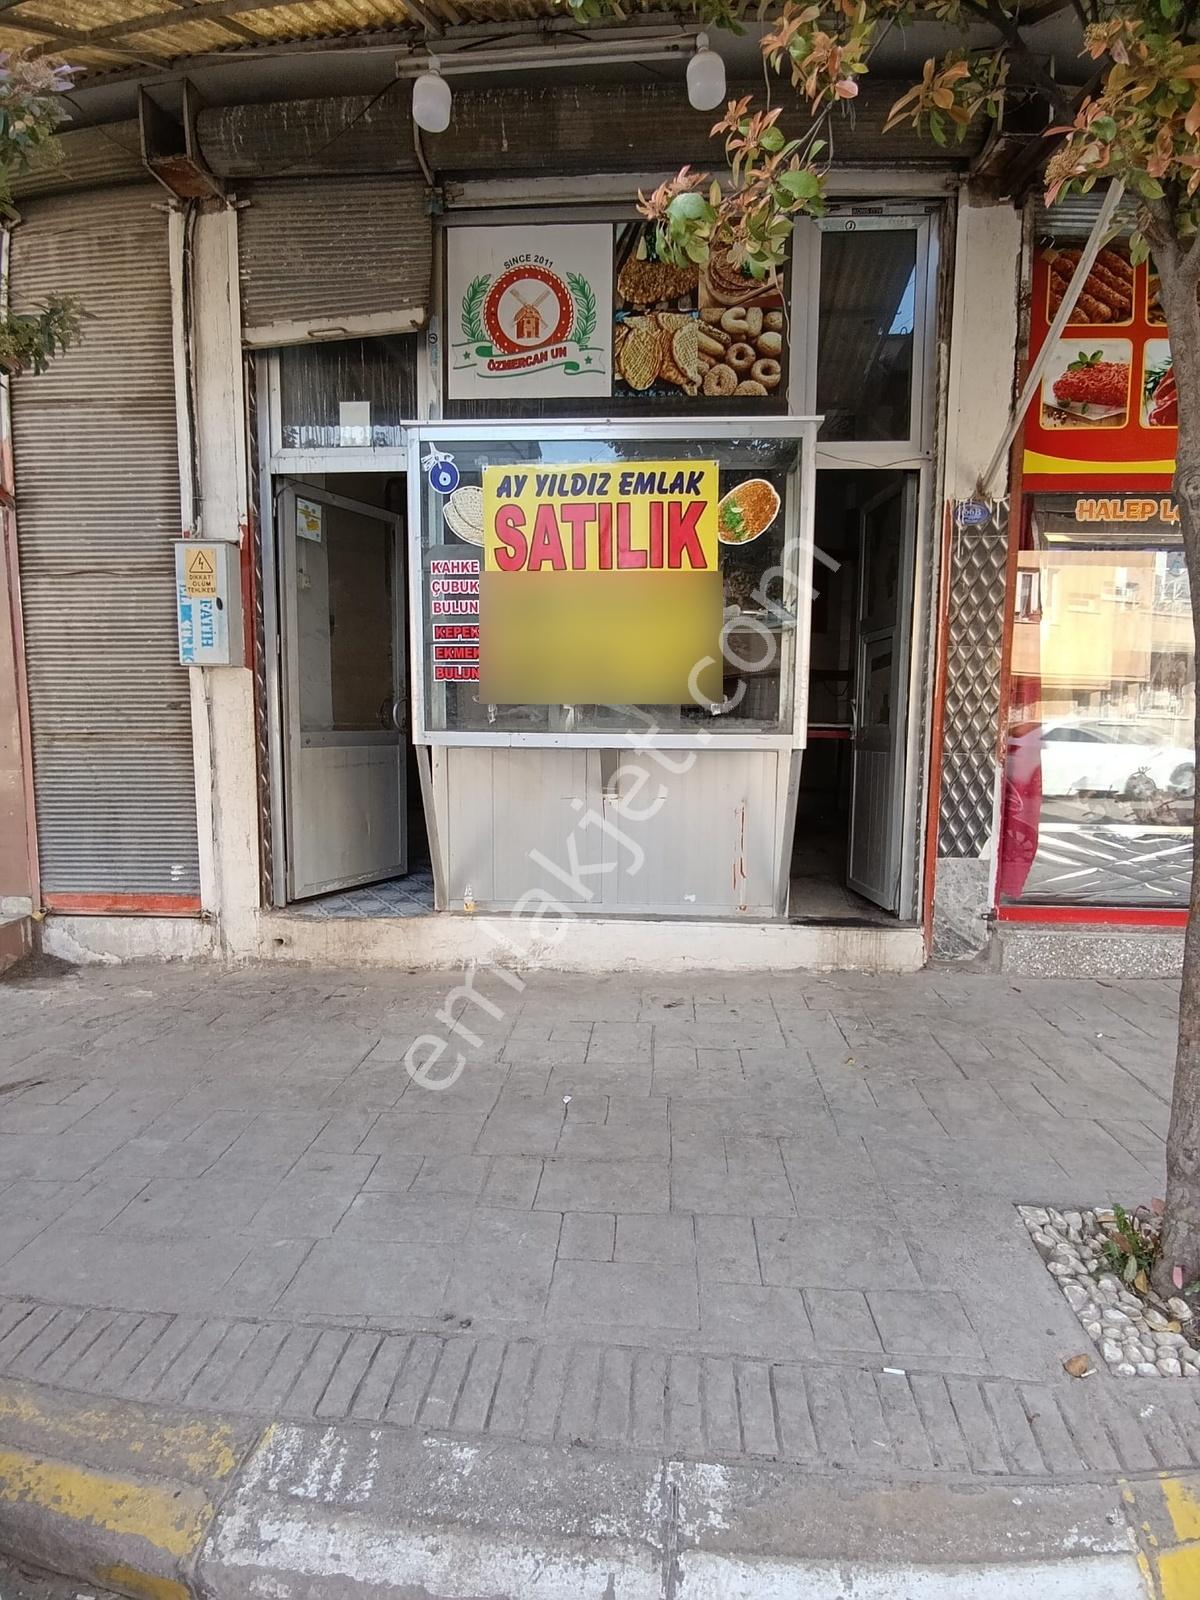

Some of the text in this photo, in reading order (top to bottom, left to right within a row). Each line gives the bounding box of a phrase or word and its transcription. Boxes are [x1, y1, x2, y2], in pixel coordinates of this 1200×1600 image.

[503, 253, 554, 270] SINCE 2011
[550, 346, 567, 360] UN
[496, 470, 705, 498] AY YILDIZ EMLAK
[1075, 498, 1159, 522] HALEP
[494, 500, 708, 572] SATILIK
[430, 560, 480, 575] KAHKE
[430, 579, 480, 597] ÇUBUK
